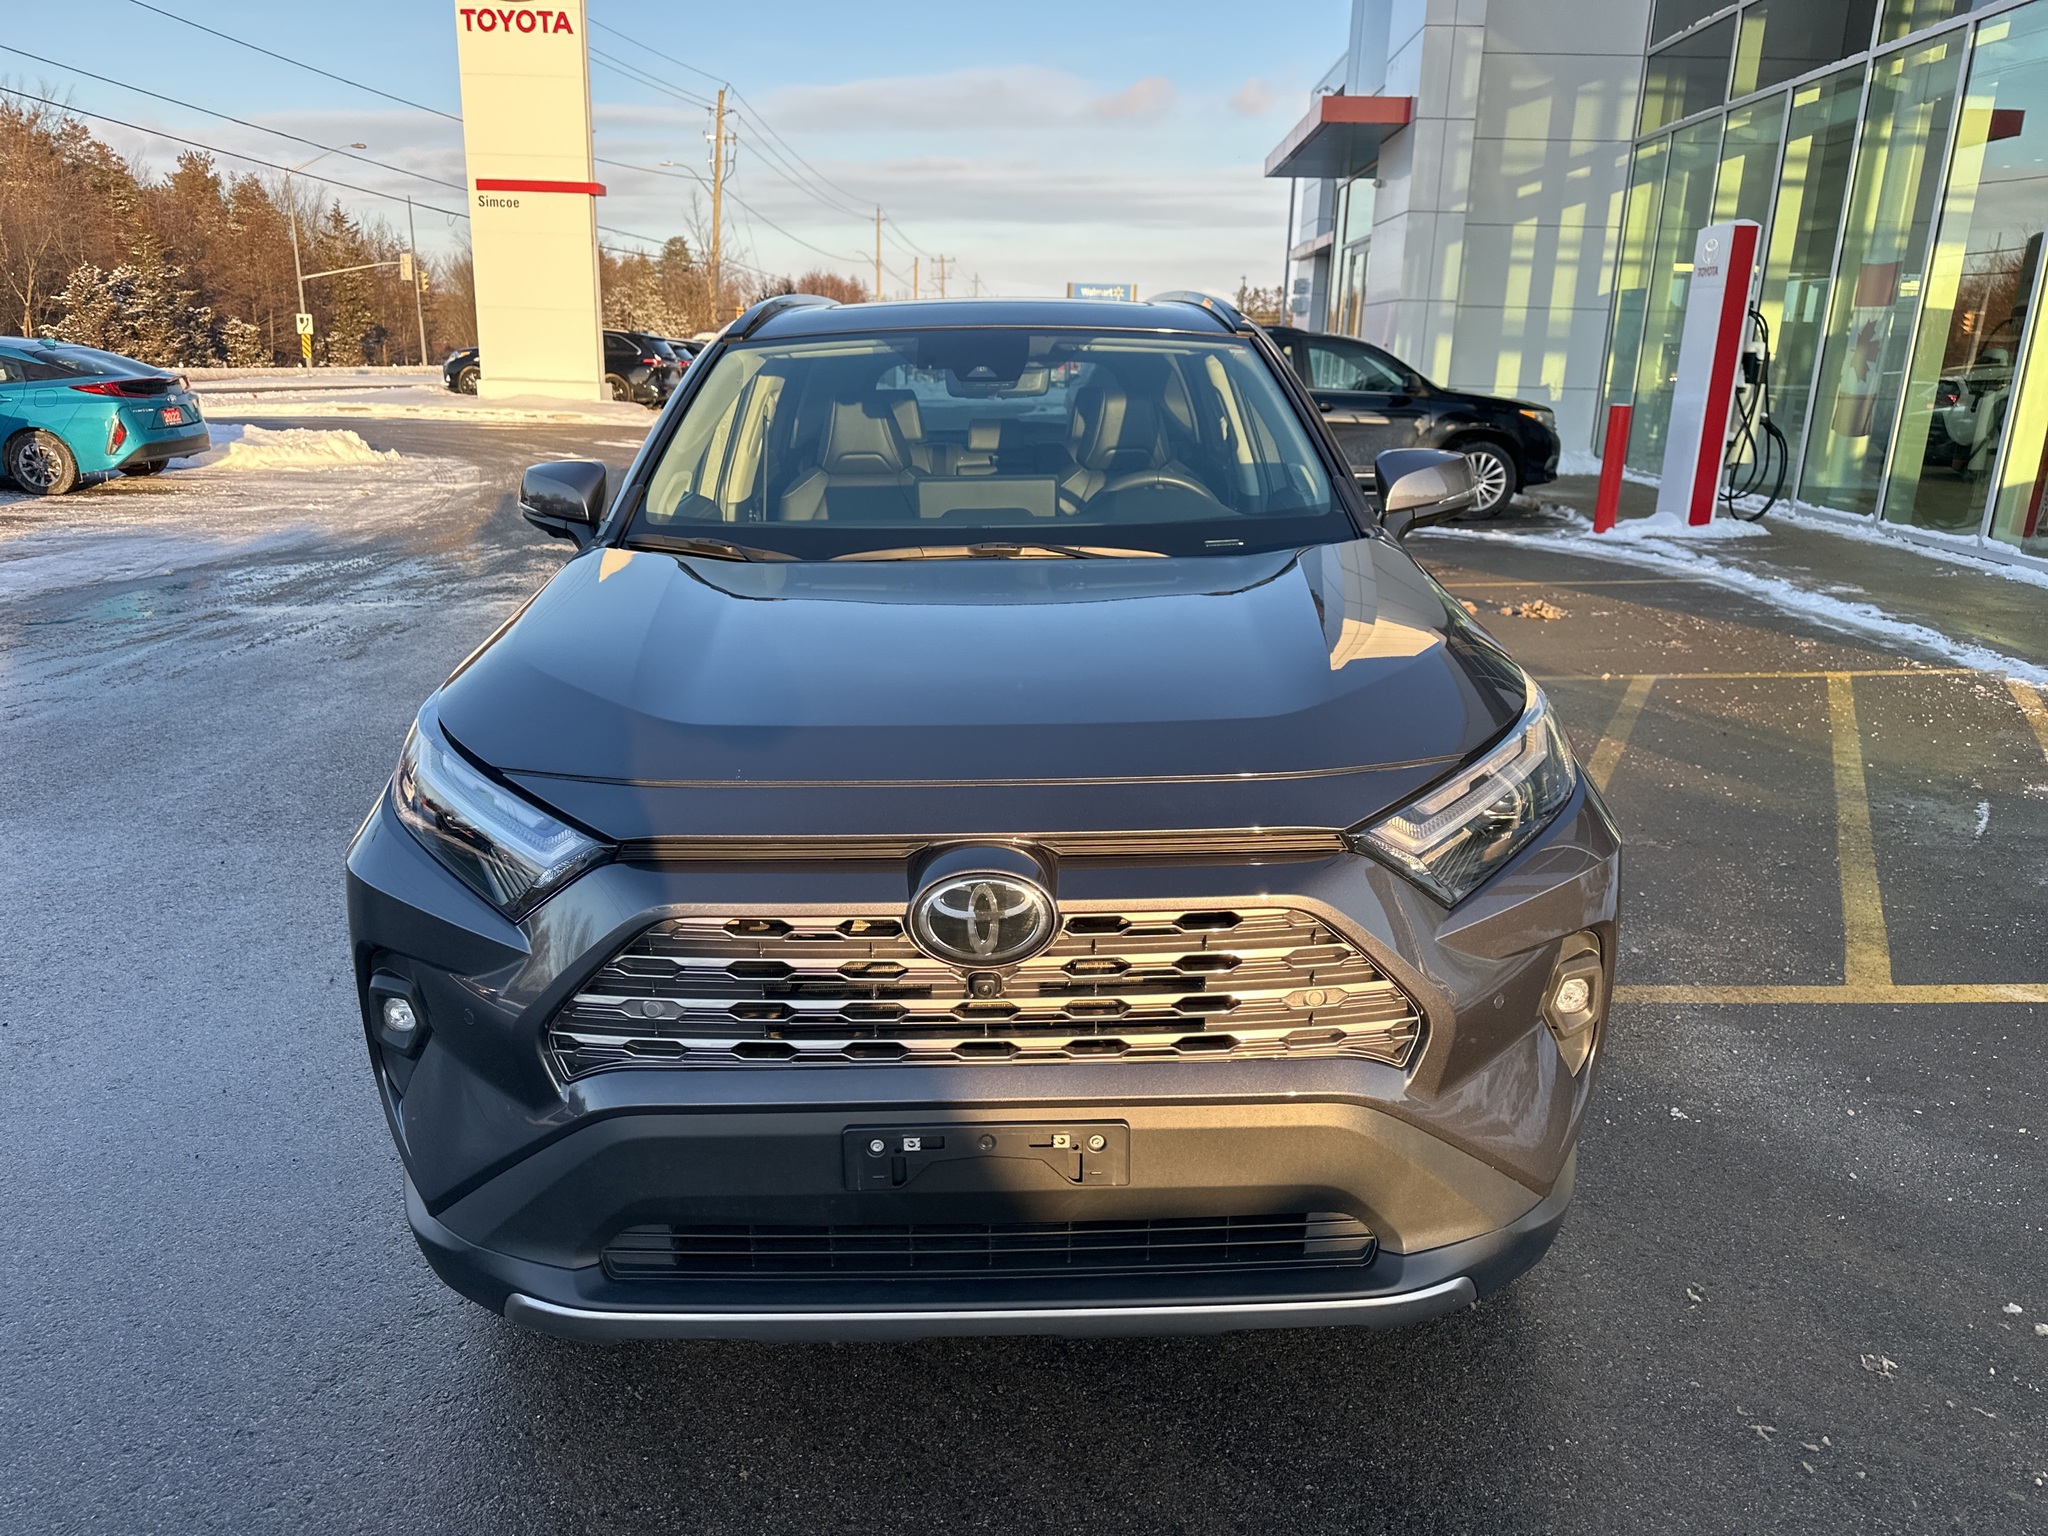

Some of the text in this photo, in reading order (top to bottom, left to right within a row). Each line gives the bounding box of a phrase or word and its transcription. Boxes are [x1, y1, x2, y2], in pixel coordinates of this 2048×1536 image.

[460, 8, 574, 34] TOYOTA
[478, 195, 520, 208] Simcoe
[1080, 286, 1114, 298] Walmart
[163, 411, 181, 422] 2022
